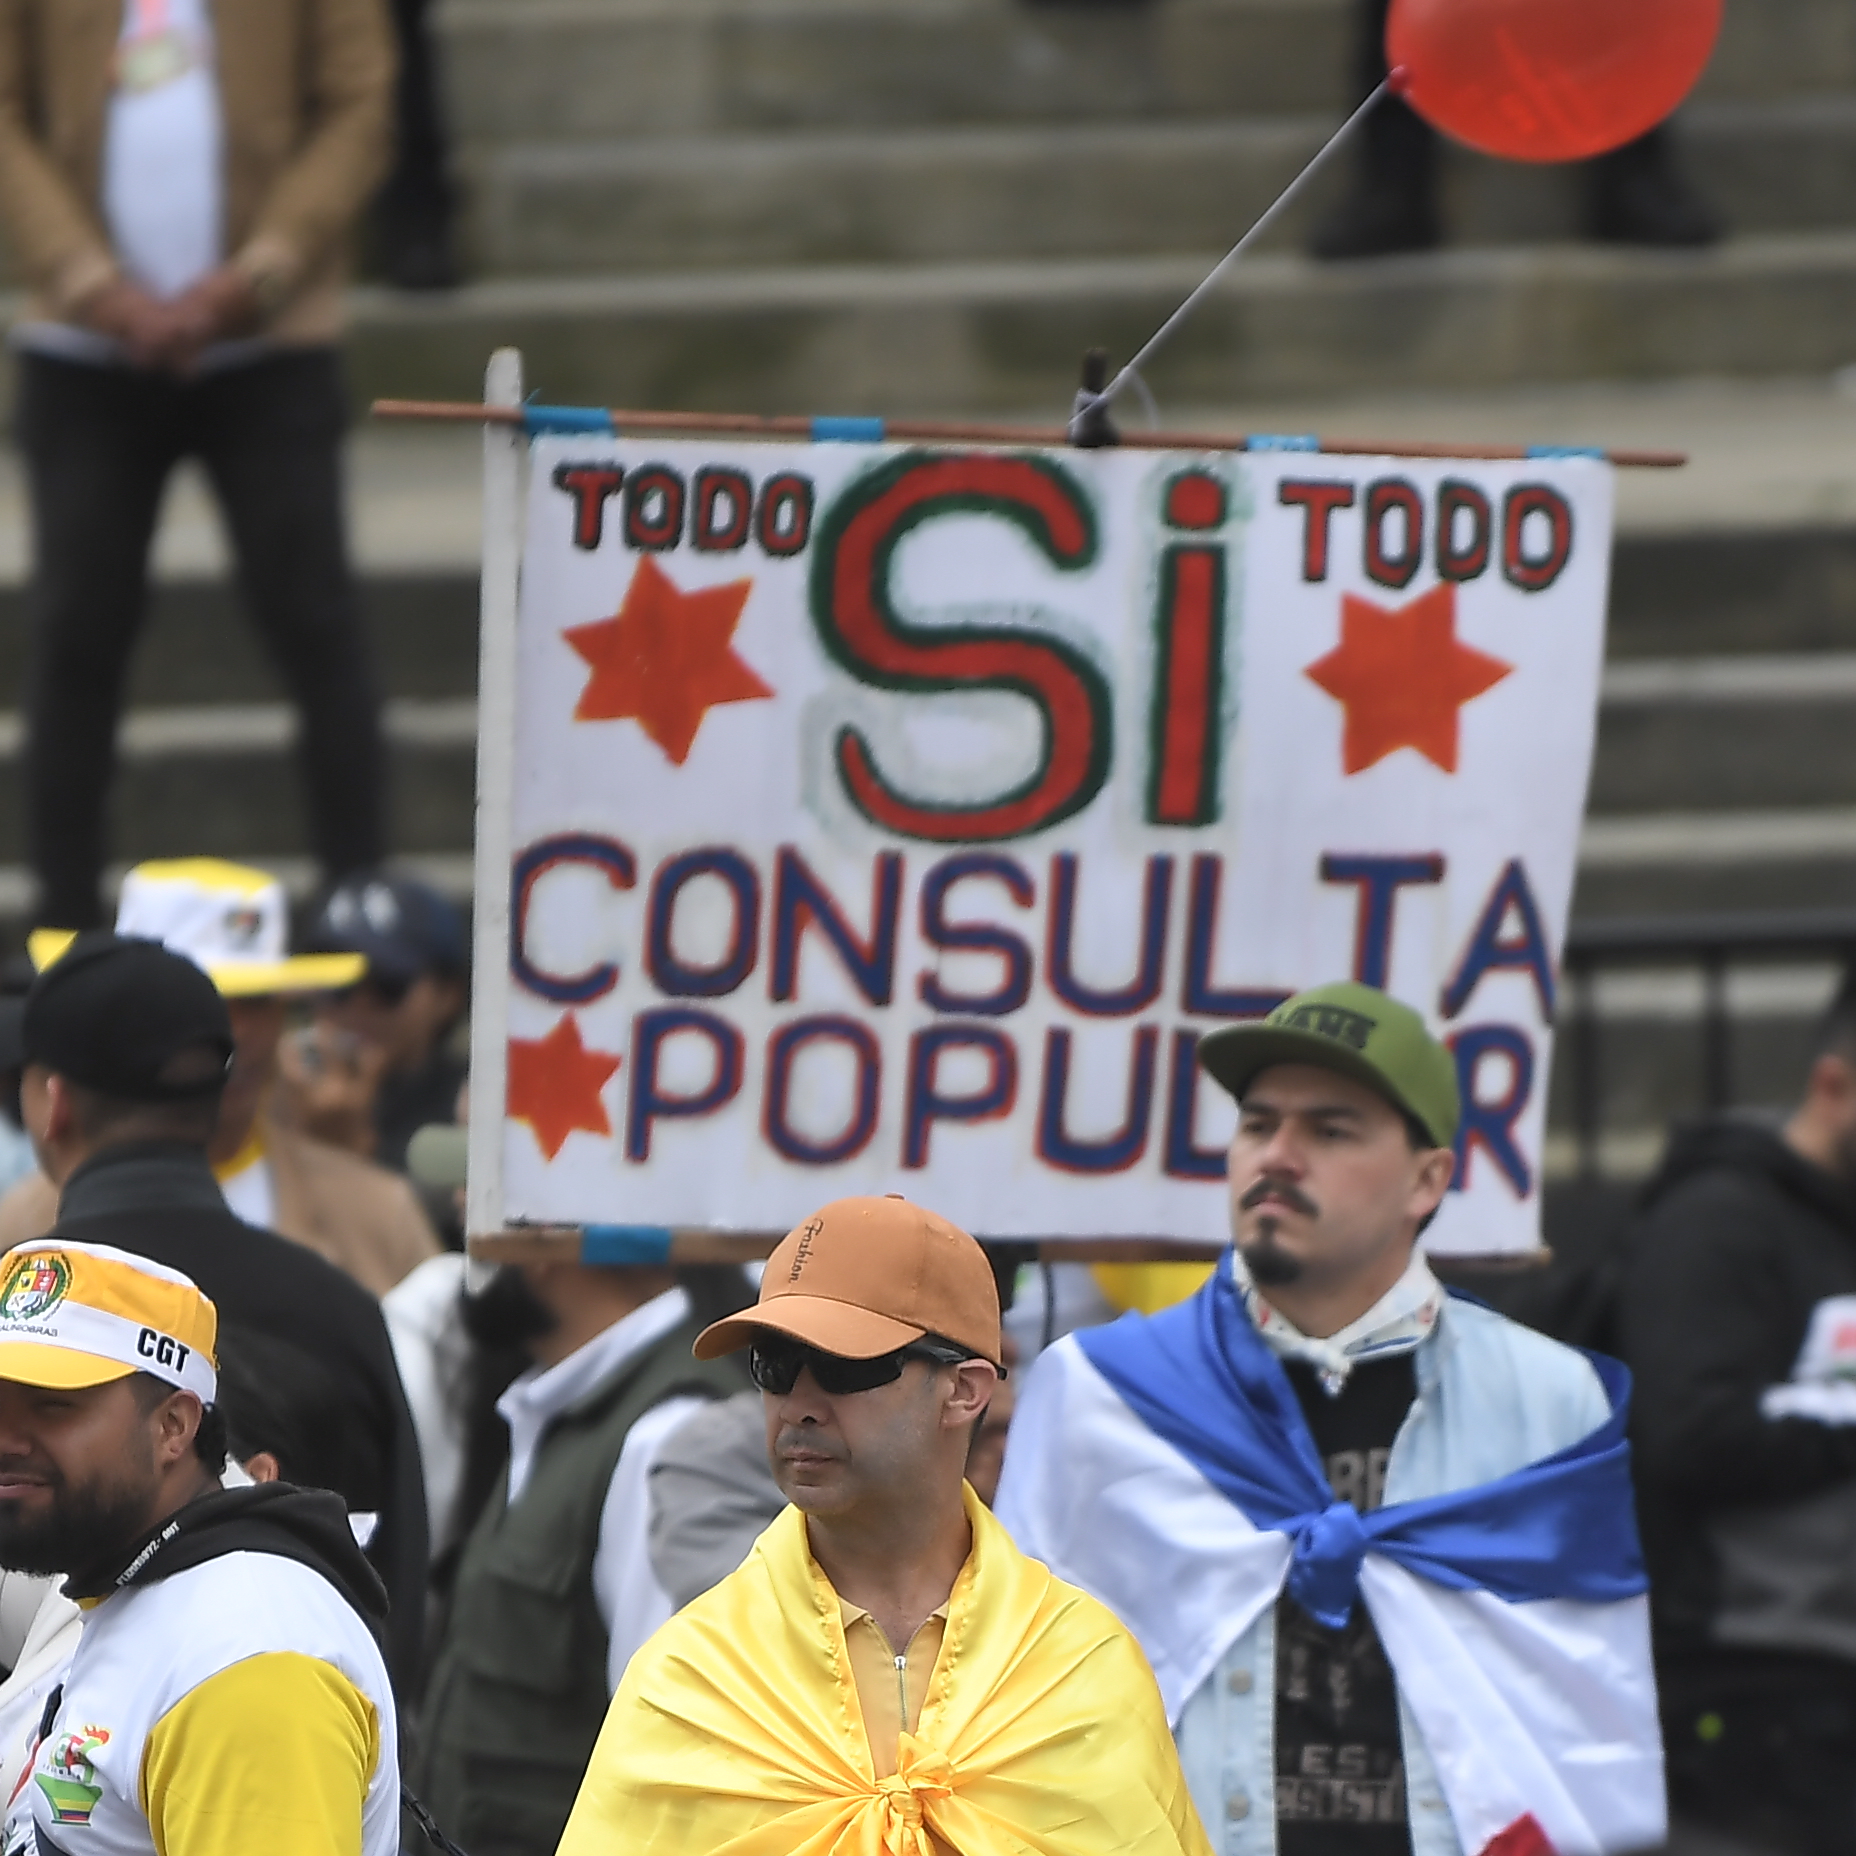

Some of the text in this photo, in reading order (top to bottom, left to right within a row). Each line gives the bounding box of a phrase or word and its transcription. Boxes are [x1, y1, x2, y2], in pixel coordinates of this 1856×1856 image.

[555, 462, 815, 556] TODO
[1279, 477, 1574, 591] TODO
[508, 830, 1556, 1022] CONSULTA
[1273, 1001, 1377, 1048] VANS
[625, 1005, 1534, 1199] POPULR
[788, 1218, 824, 1283] Fashion
[136, 1327, 191, 1374] CGT
